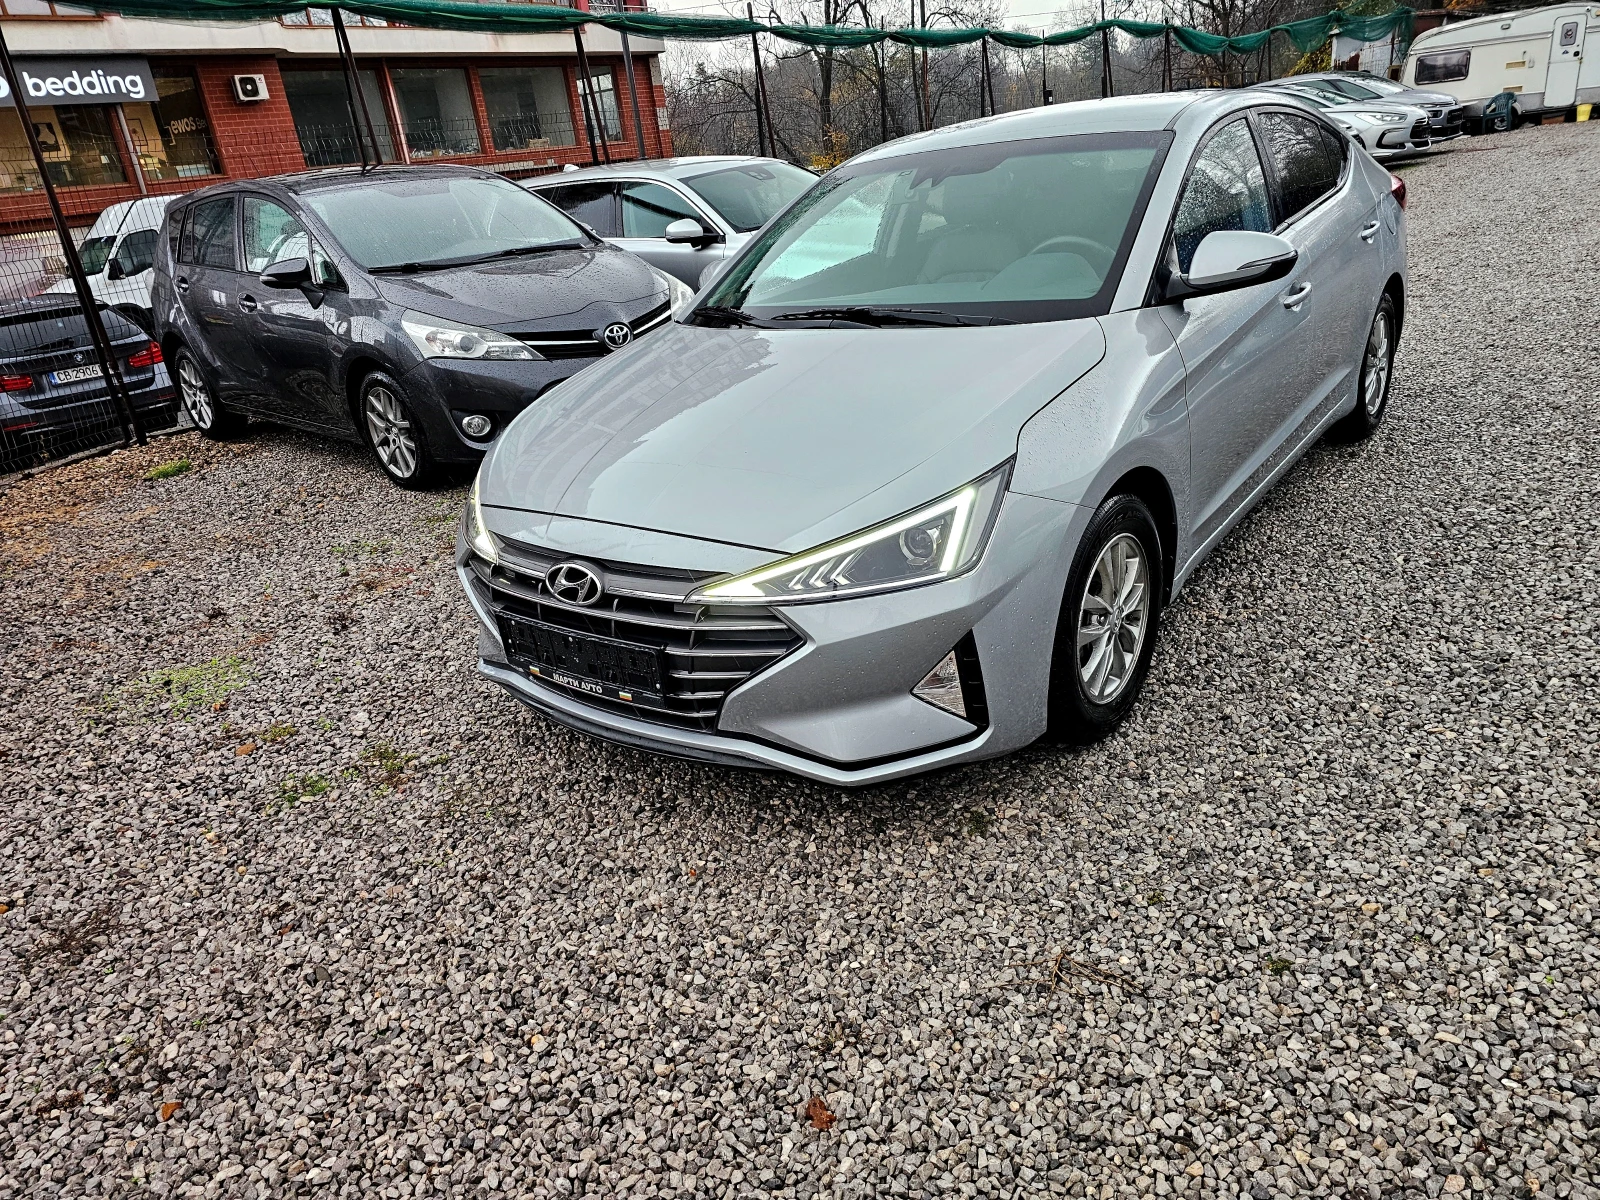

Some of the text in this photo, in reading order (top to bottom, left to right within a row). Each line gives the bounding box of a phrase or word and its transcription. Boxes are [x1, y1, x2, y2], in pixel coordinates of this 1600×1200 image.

[22, 70, 145, 99] bedding
[552, 673, 603, 693] МАРТИ АУТО
